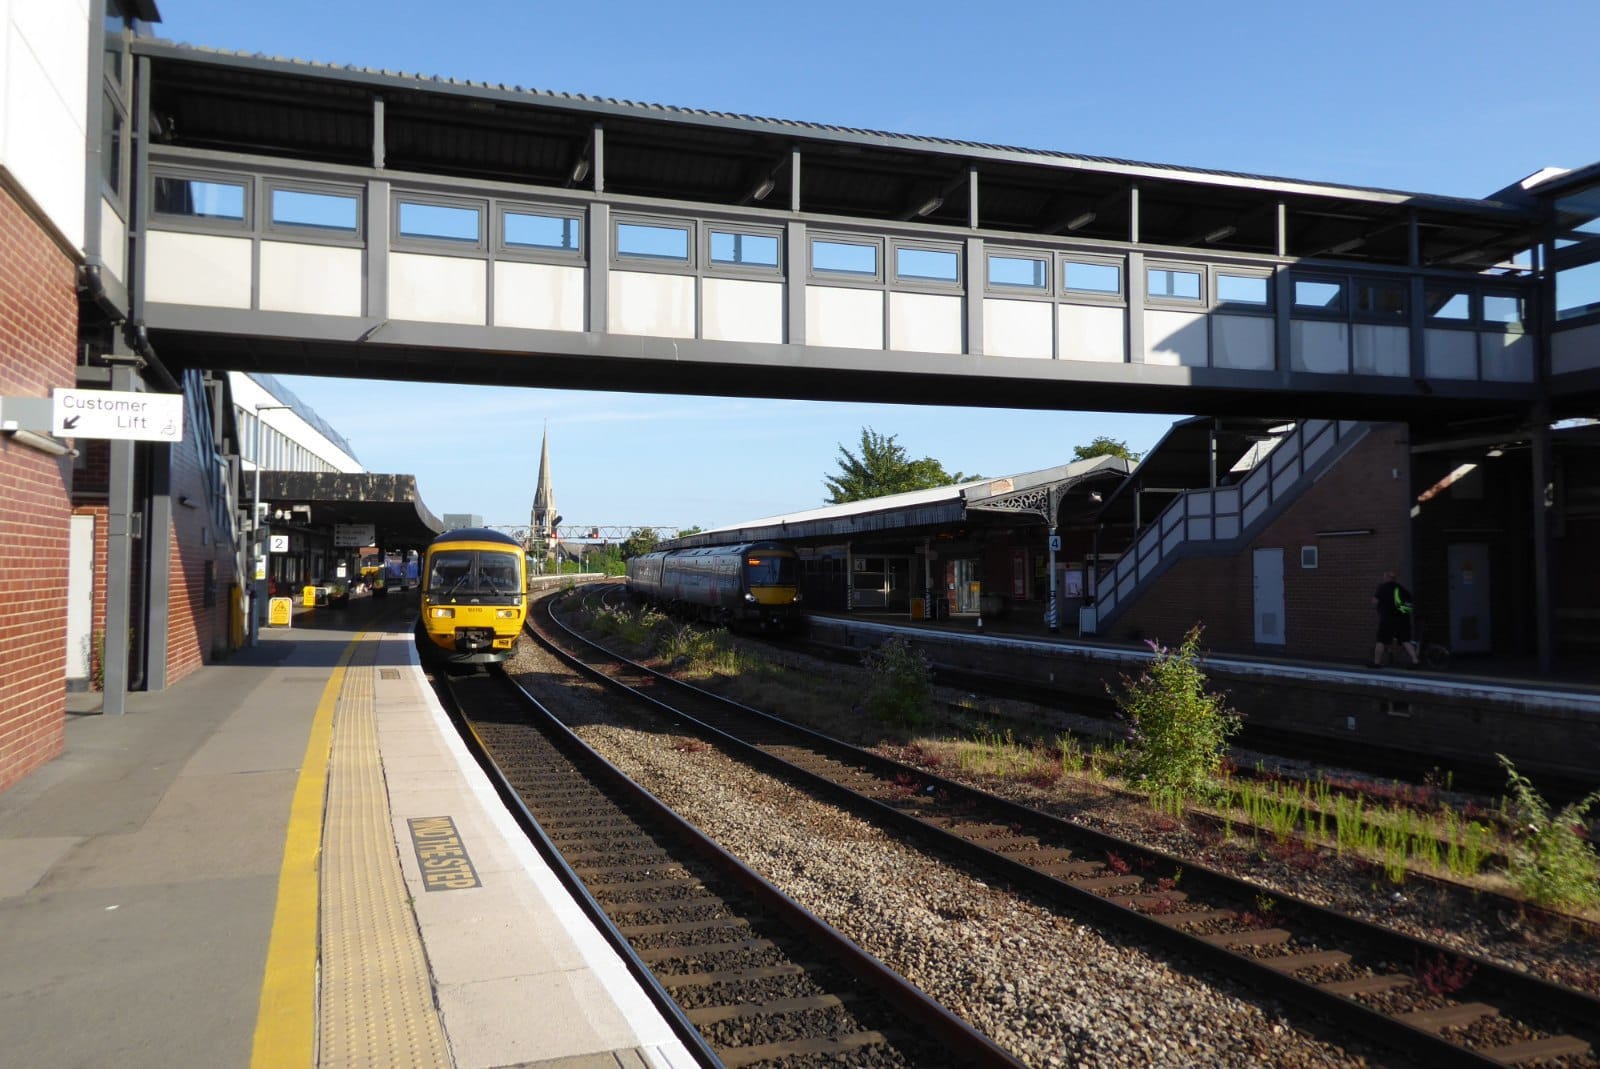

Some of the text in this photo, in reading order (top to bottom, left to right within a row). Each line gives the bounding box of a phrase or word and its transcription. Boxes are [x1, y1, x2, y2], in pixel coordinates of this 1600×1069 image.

[63, 395, 148, 412] Customer
[117, 415, 148, 429] Lift
[275, 538, 283, 549] 2
[1051, 538, 1059, 548] 4
[410, 817, 476, 888] MIND THE STEP
